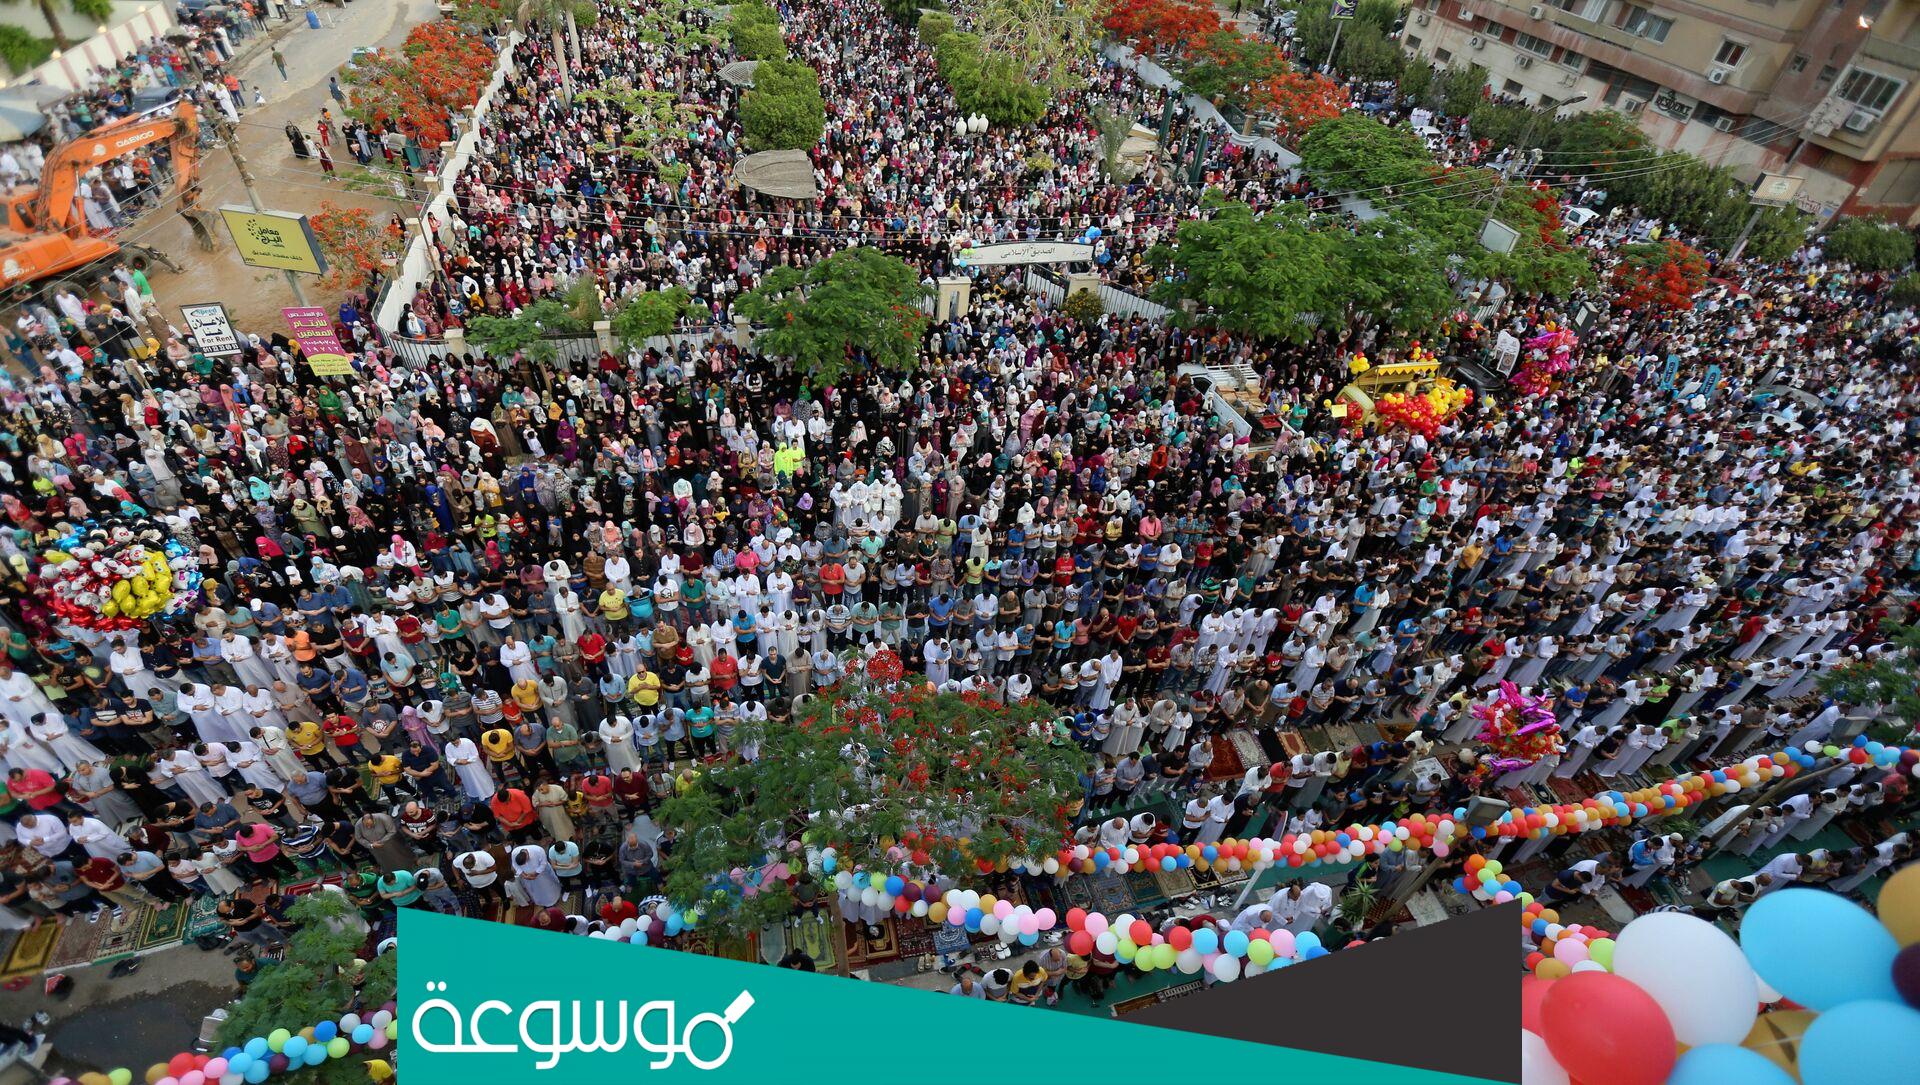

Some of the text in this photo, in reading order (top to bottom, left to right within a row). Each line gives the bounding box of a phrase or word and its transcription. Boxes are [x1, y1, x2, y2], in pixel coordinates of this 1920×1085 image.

[116, 130, 154, 147] DAEWOO
[257, 226, 279, 236] معامل
[261, 236, 282, 245] البرج
[1030, 245, 1056, 257] الصديق
[202, 327, 223, 337] هنا
[296, 329, 334, 339] المعاقين
[215, 335, 233, 343] Rent
